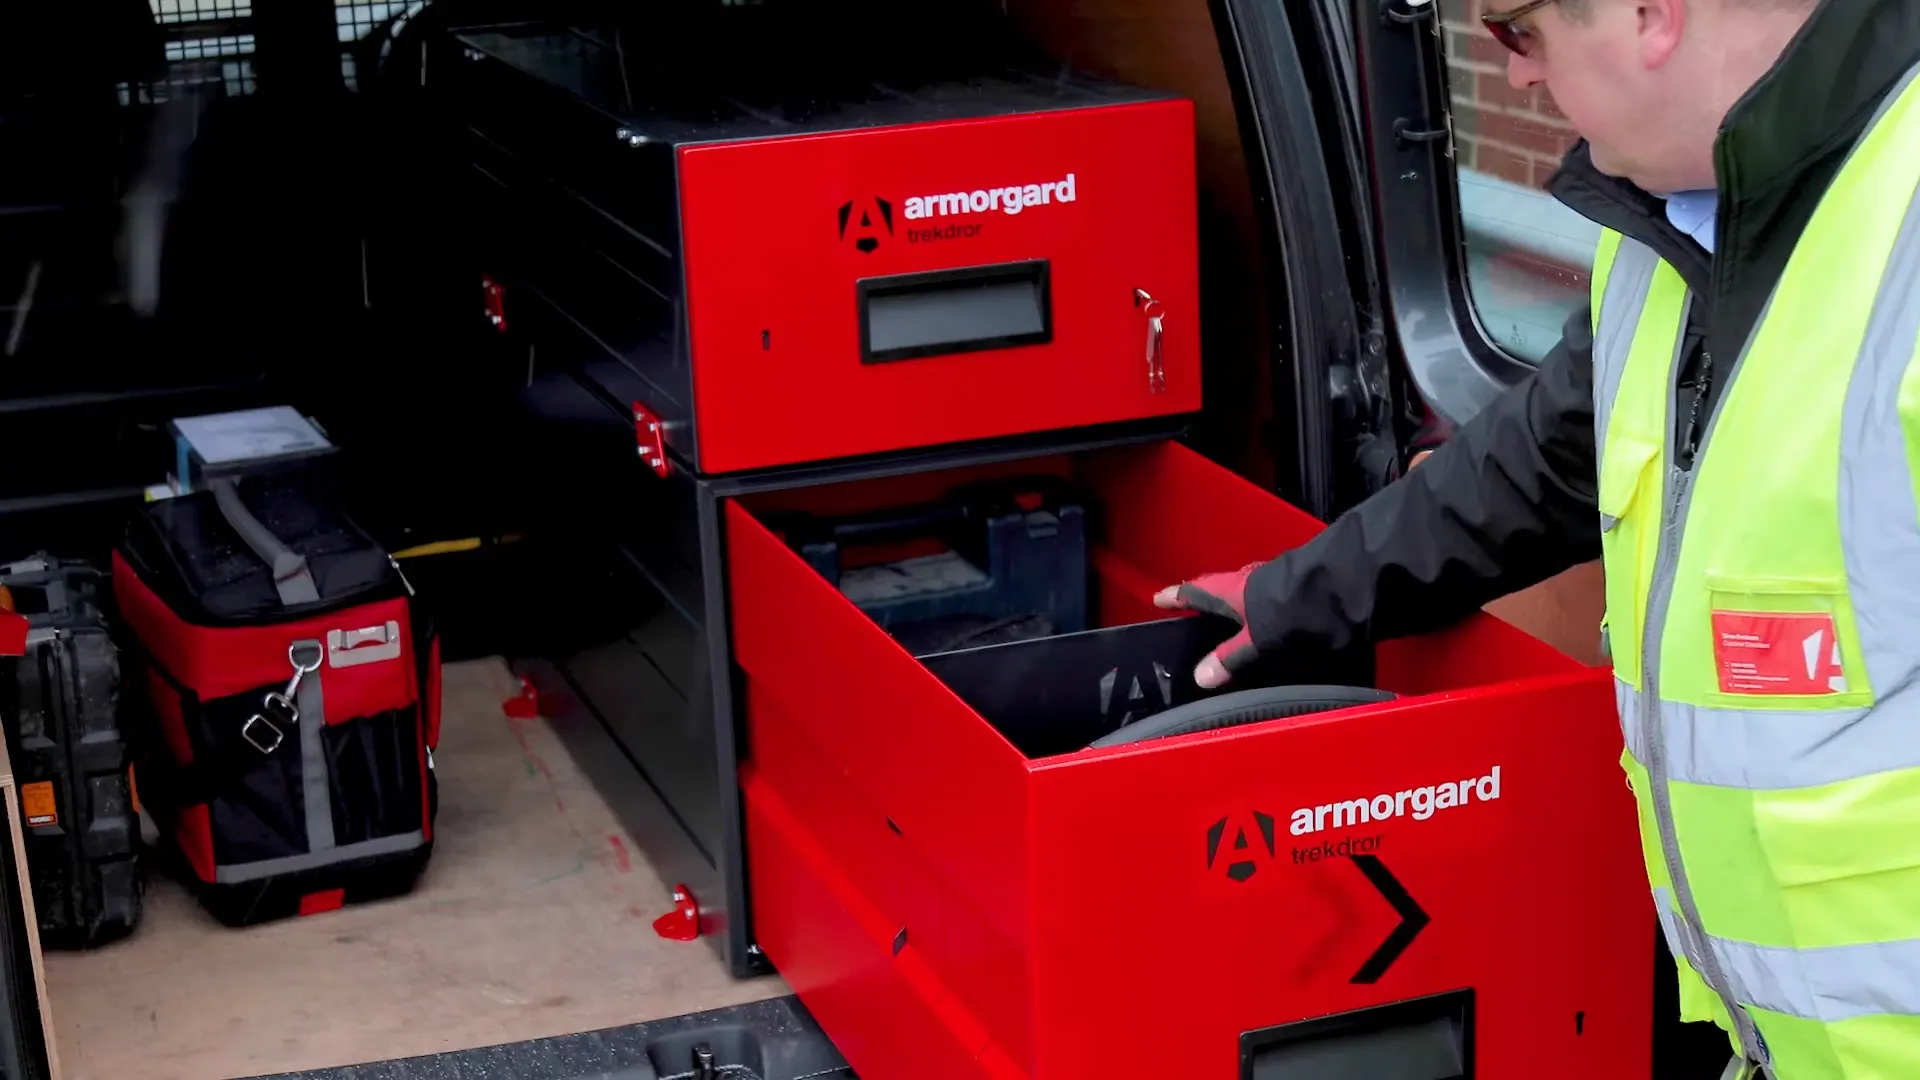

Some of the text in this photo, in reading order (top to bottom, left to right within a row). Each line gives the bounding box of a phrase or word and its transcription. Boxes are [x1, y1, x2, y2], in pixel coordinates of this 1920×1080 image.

[904, 173, 1076, 220] armorgard
[906, 222, 983, 244] trekdror
[1289, 765, 1501, 836] armorgard
[1292, 833, 1384, 865] trekdror
